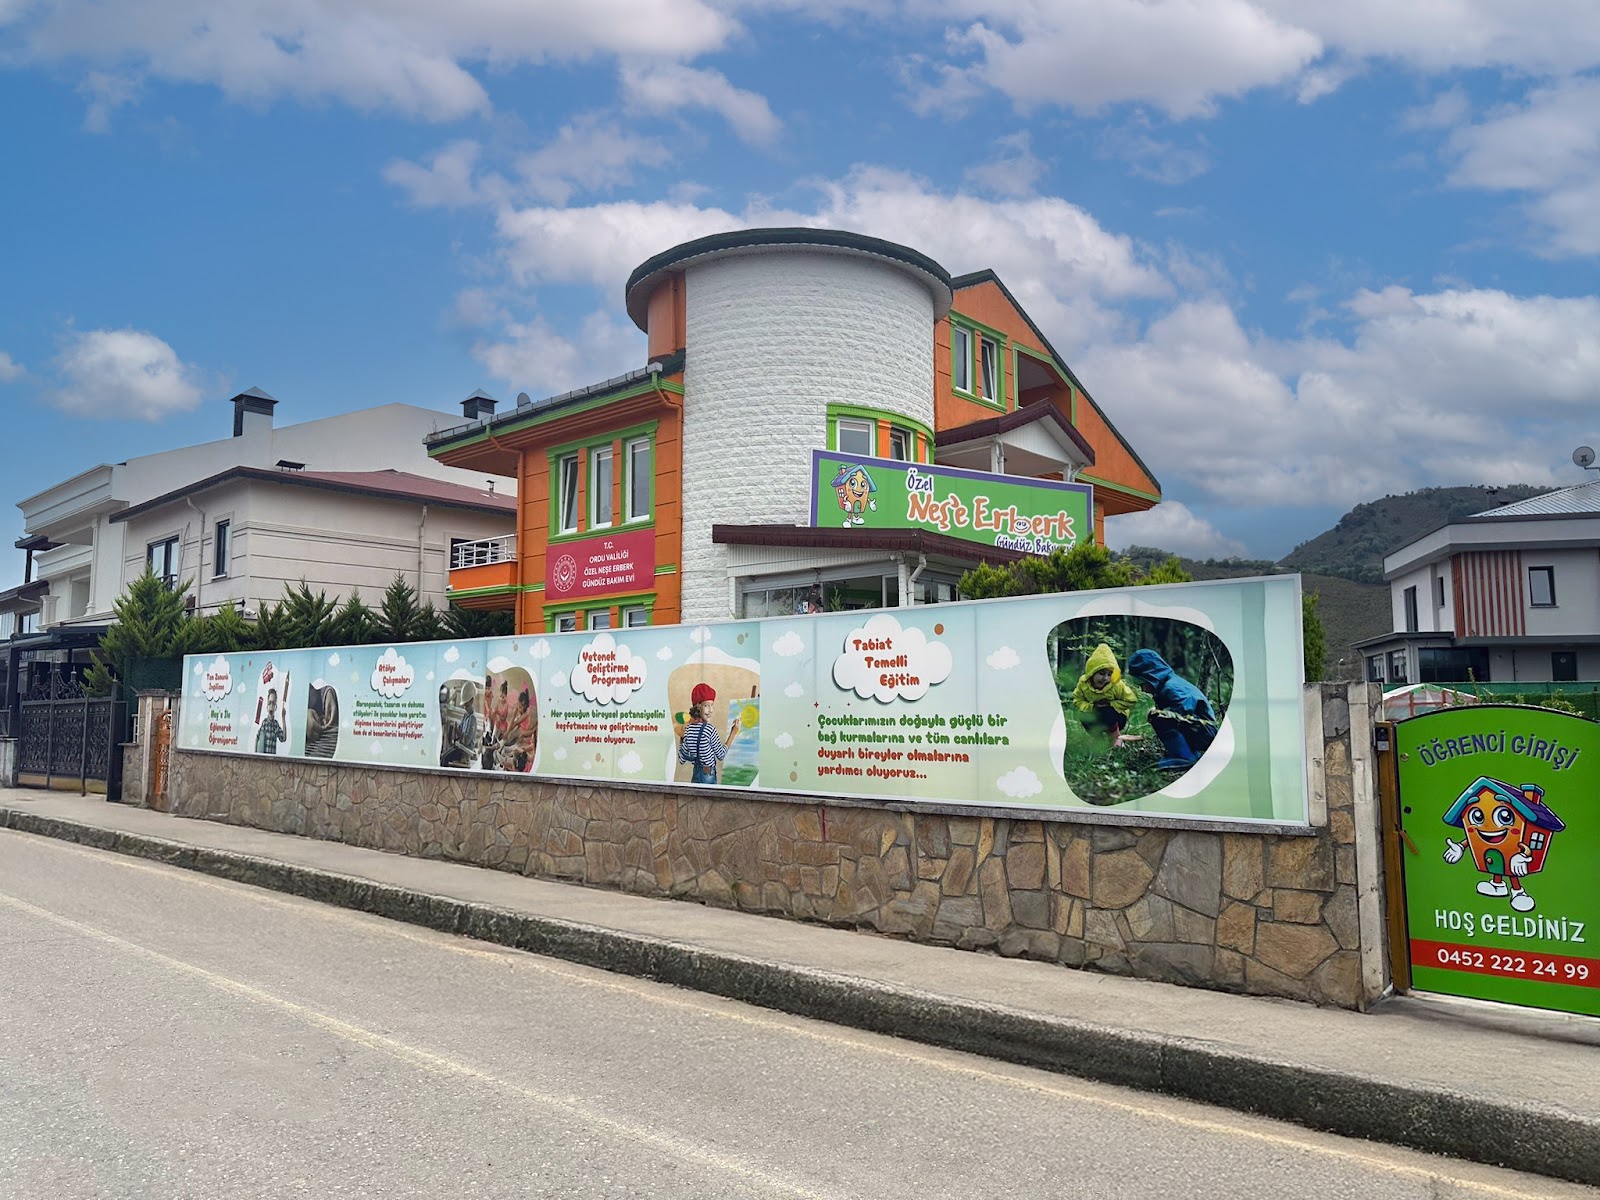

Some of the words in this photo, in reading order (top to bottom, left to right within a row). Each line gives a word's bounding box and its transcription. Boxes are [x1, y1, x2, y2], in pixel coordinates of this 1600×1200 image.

[908, 469, 933, 492] Özel
[974, 497, 1075, 538] Erberk
[996, 536, 1032, 552] Gündüz
[606, 549, 629, 561] VALİLİĞİ
[584, 567, 597, 576] ÖZEL
[598, 565, 612, 575] NEŞE
[613, 563, 633, 572] ERBERK
[582, 577, 605, 588] GÜNDÜZ
[607, 576, 624, 585] BAKIM
[626, 573, 635, 583] EVİ
[853, 637, 892, 651] Tabiat
[582, 651, 616, 662] Yetenek
[865, 655, 908, 669] Temelli
[379, 664, 395, 673] Atölye
[587, 663, 628, 675] Geliştirme
[383, 676, 410, 686] Çalışmaları
[591, 674, 641, 686] Programları
[880, 674, 919, 688] Eğitim
[551, 710, 563, 718] Her
[564, 710, 590, 720] çocuğun
[591, 710, 618, 719] bireysel
[620, 709, 666, 720] potansiyelini
[818, 714, 896, 729] Çocuklarımızın
[900, 714, 946, 729] doğayla
[949, 713, 983, 730] güçlü
[988, 713, 1007, 727] bir
[556, 721, 598, 732] keşfetmesine
[609, 722, 658, 733] geliştirmesine
[574, 735, 602, 743] yardımcı
[604, 735, 635, 745] oluyoruz.
[818, 731, 837, 744] bağ
[840, 731, 904, 744] kurmalarına
[909, 734, 922, 744] ve
[925, 732, 950, 744] tüm
[954, 731, 1009, 746] canlılara
[818, 747, 854, 761] duyarlı
[858, 749, 903, 762] bireyler
[907, 749, 969, 763] olmalarına
[1418, 729, 1506, 767] ÖĞRENCİ
[1510, 733, 1581, 771] GİRİŞİ
[818, 765, 863, 777] yardımcı
[866, 765, 927, 779] oluyoruz...
[1435, 909, 1475, 937] HOŞ
[1480, 913, 1586, 943] GELDİNİZ
[1437, 949, 1485, 968] 0452
[1490, 954, 1526, 973] 222
[1532, 959, 1557, 977] 24
[1564, 962, 1588, 980] 99
